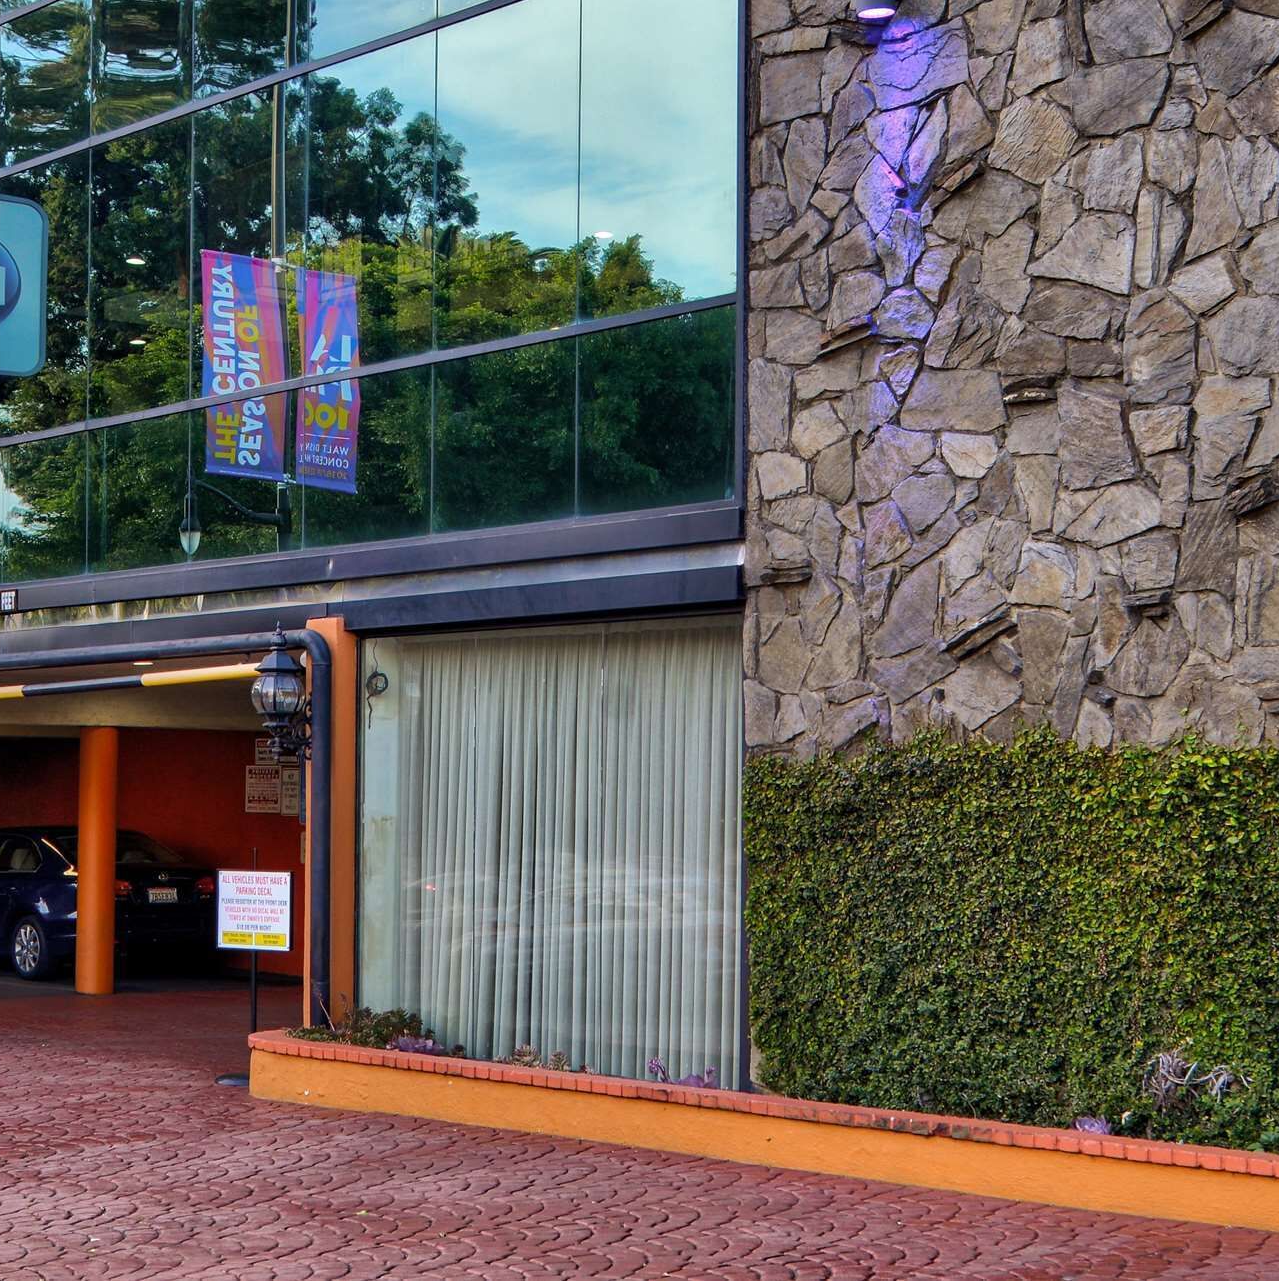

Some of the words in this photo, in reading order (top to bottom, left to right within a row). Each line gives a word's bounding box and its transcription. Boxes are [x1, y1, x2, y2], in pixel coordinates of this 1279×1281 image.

[1, 591, 16, 611] FEET
[222, 875, 231, 884] ALL
[232, 875, 254, 885] VEHICLES
[255, 876, 269, 885] MUST
[270, 877, 283, 886] HAVE
[235, 887, 257, 896] PARKING
[258, 888, 272, 897] DECAL
